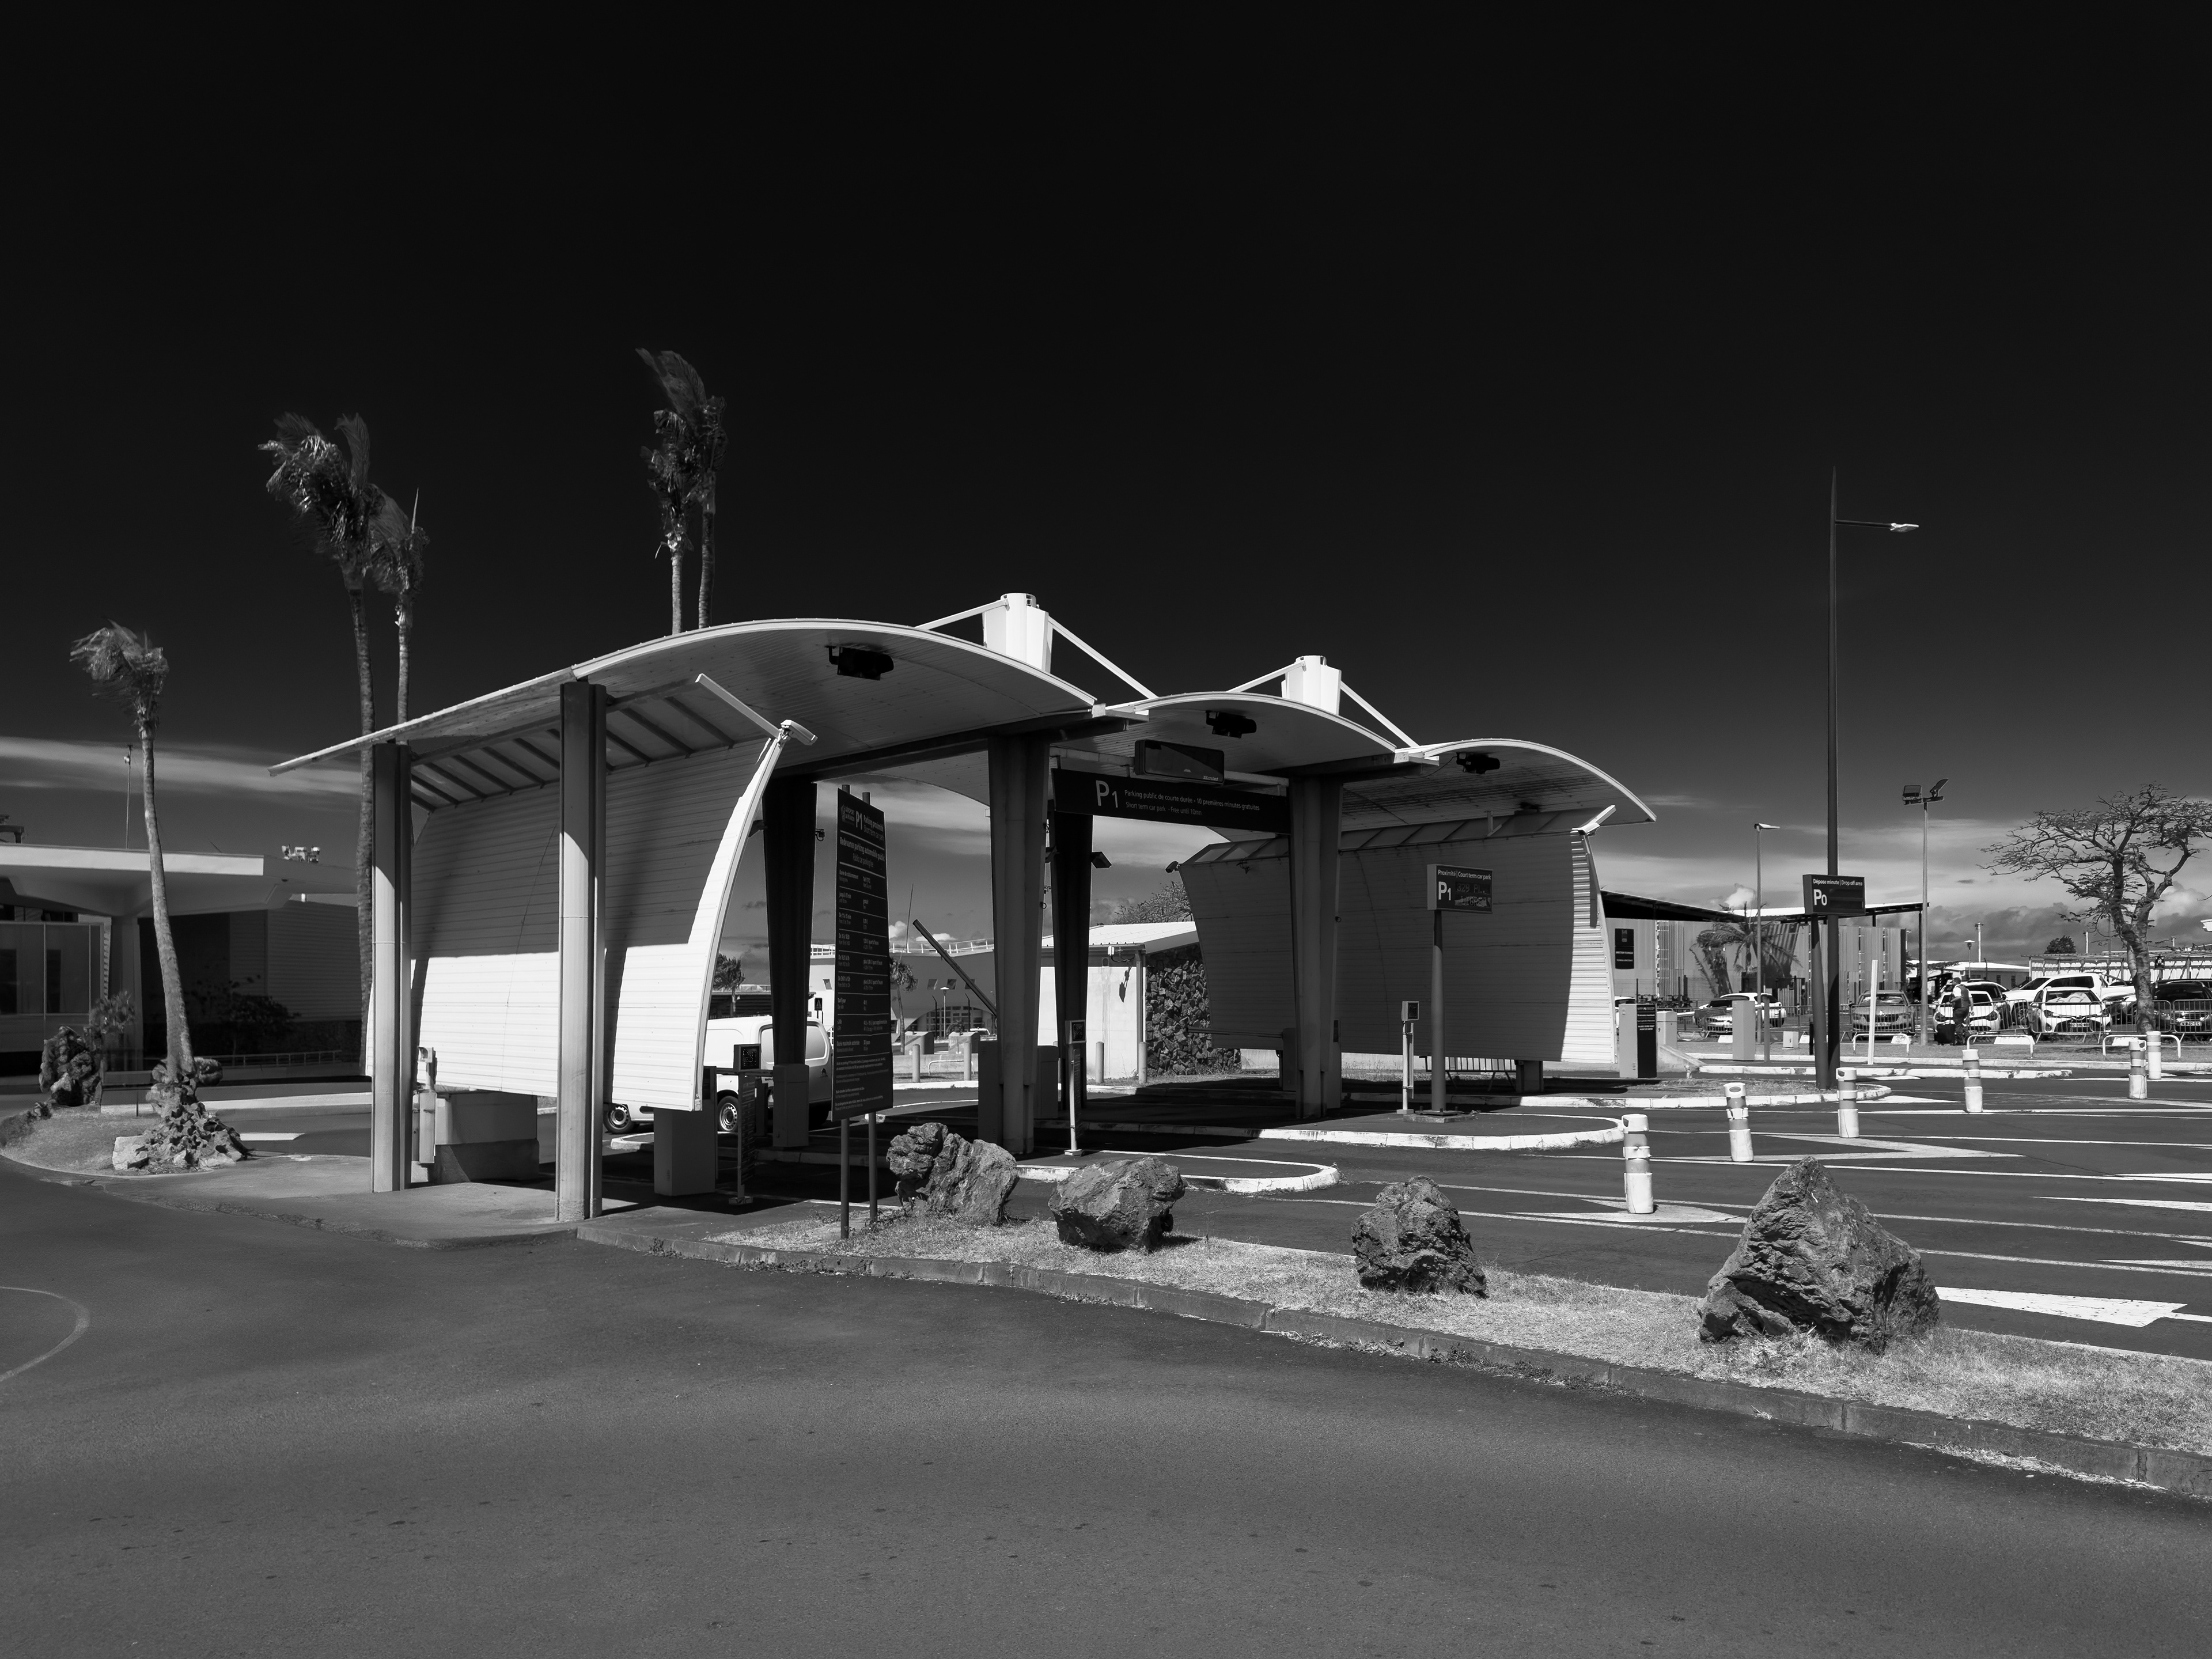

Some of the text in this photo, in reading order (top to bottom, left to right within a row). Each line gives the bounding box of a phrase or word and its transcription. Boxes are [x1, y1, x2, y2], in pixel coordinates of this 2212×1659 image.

[1096, 780, 1118, 808] P1
[1124, 790, 1143, 800] Parking
[1203, 800, 1224, 808] premières
[1157, 804, 1166, 812] park
[856, 810, 862, 830] P1
[1438, 869, 1456, 877] Proximité
[1438, 881, 1452, 901] P1
